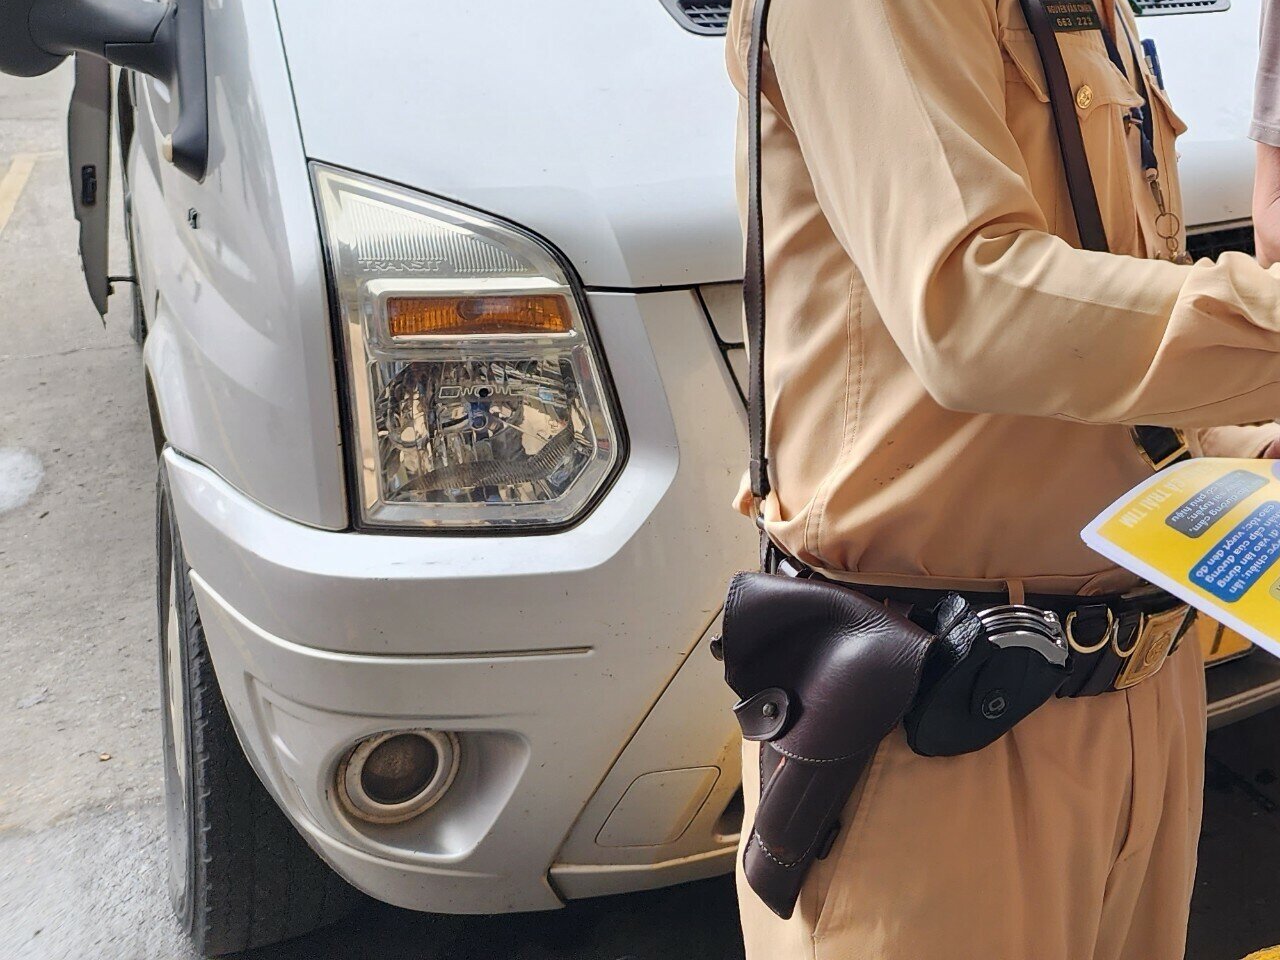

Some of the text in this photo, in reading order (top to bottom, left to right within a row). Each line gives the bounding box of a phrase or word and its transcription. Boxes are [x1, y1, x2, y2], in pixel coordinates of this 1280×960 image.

[1120, 507, 1145, 527] TIM
[1233, 540, 1249, 554] của
[1253, 538, 1269, 551] vào
[1204, 555, 1236, 582] đường
